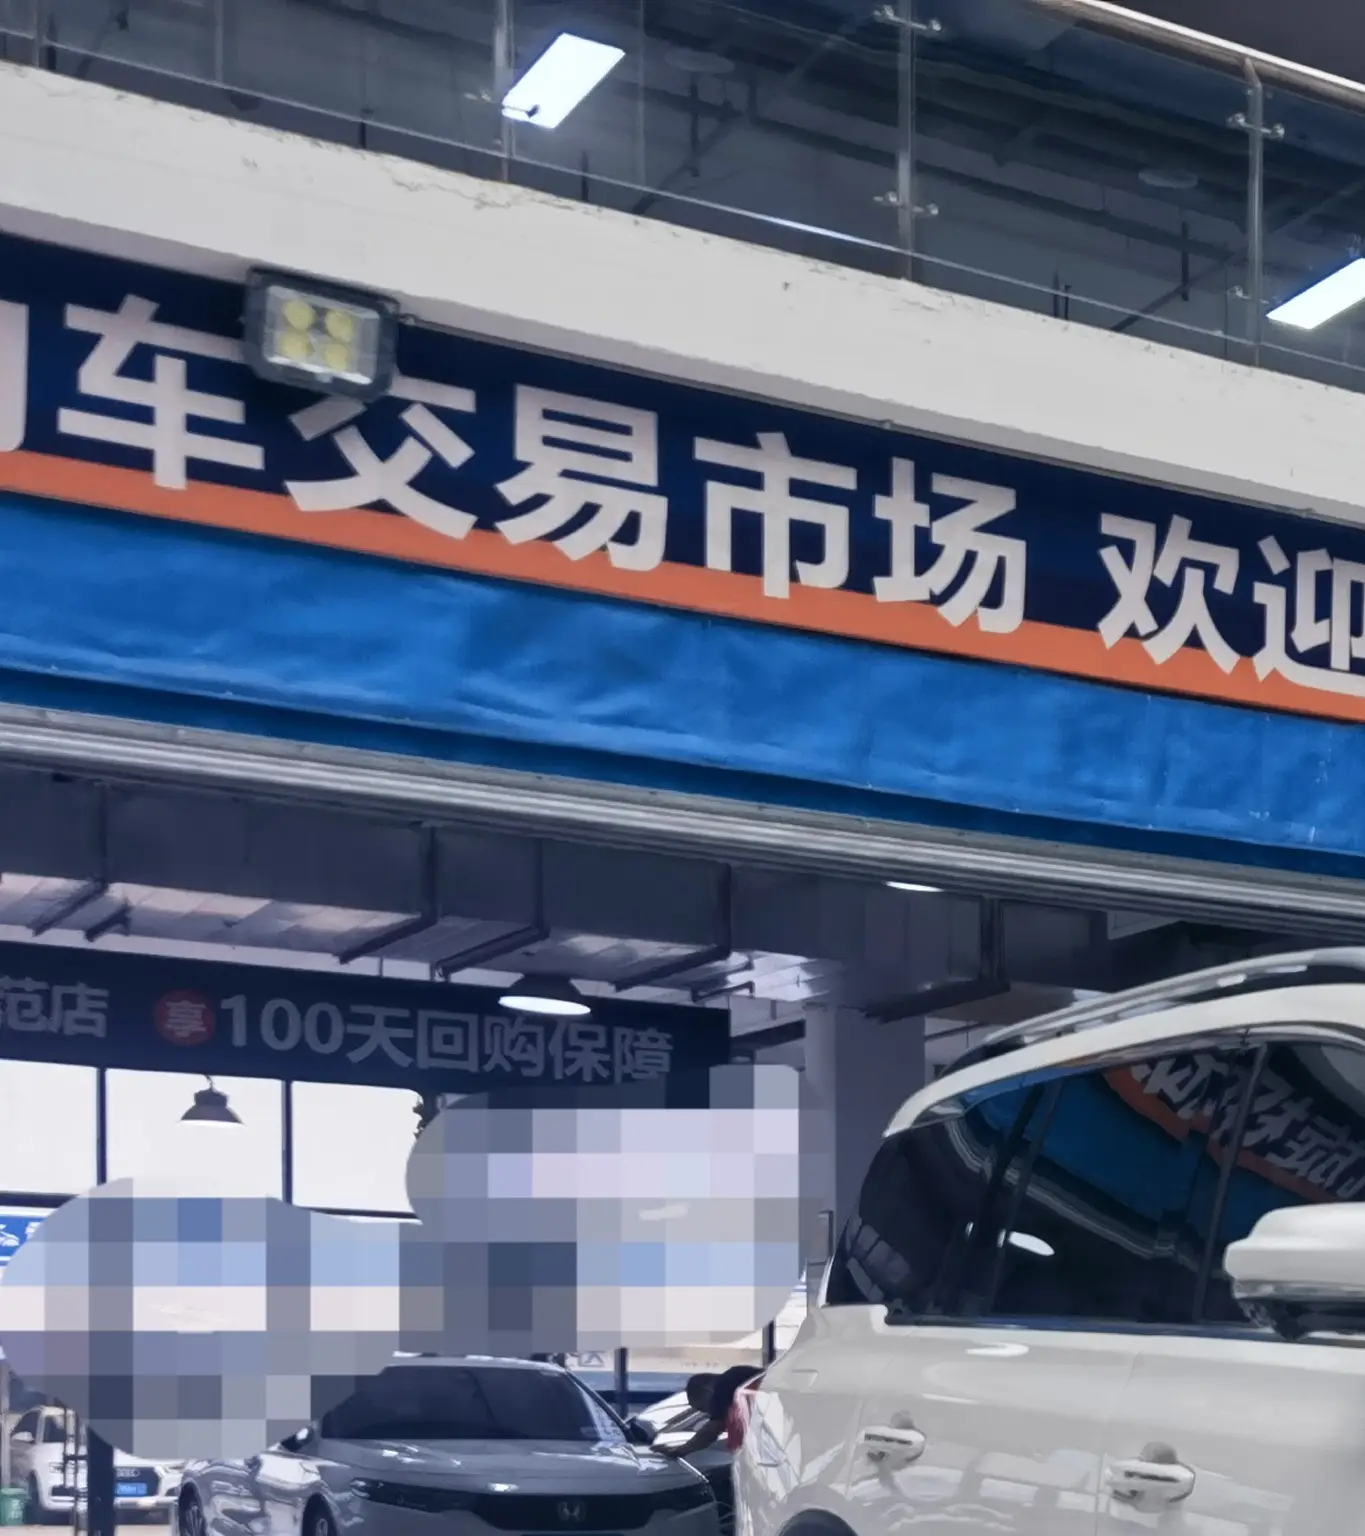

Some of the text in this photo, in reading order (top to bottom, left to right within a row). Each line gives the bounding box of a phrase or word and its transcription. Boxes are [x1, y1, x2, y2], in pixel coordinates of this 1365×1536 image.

[219, 993, 674, 1084] 100天回购保障
